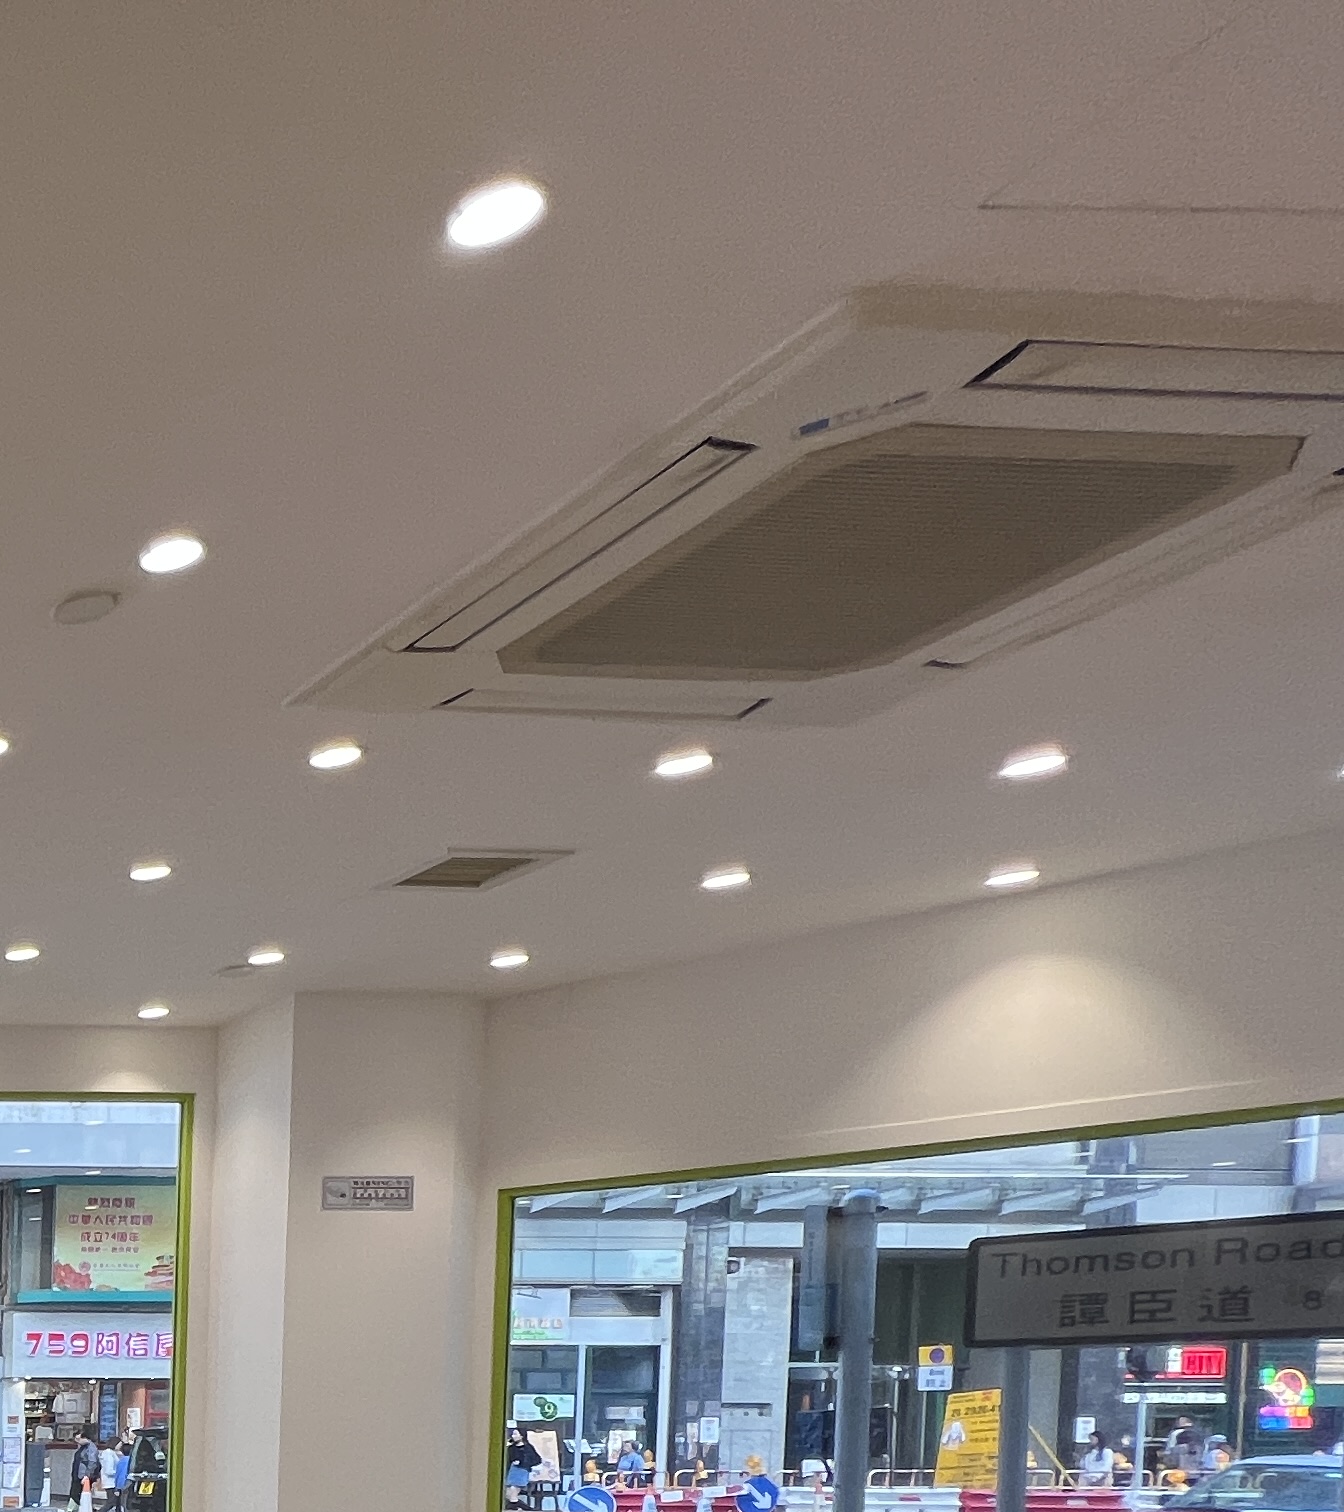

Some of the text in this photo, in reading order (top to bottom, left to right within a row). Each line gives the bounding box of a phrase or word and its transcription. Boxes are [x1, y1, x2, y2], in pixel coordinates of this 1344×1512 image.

[992, 1234, 1344, 1278] Thomson Road
[1059, 1286, 1256, 1328] 譚臣道
